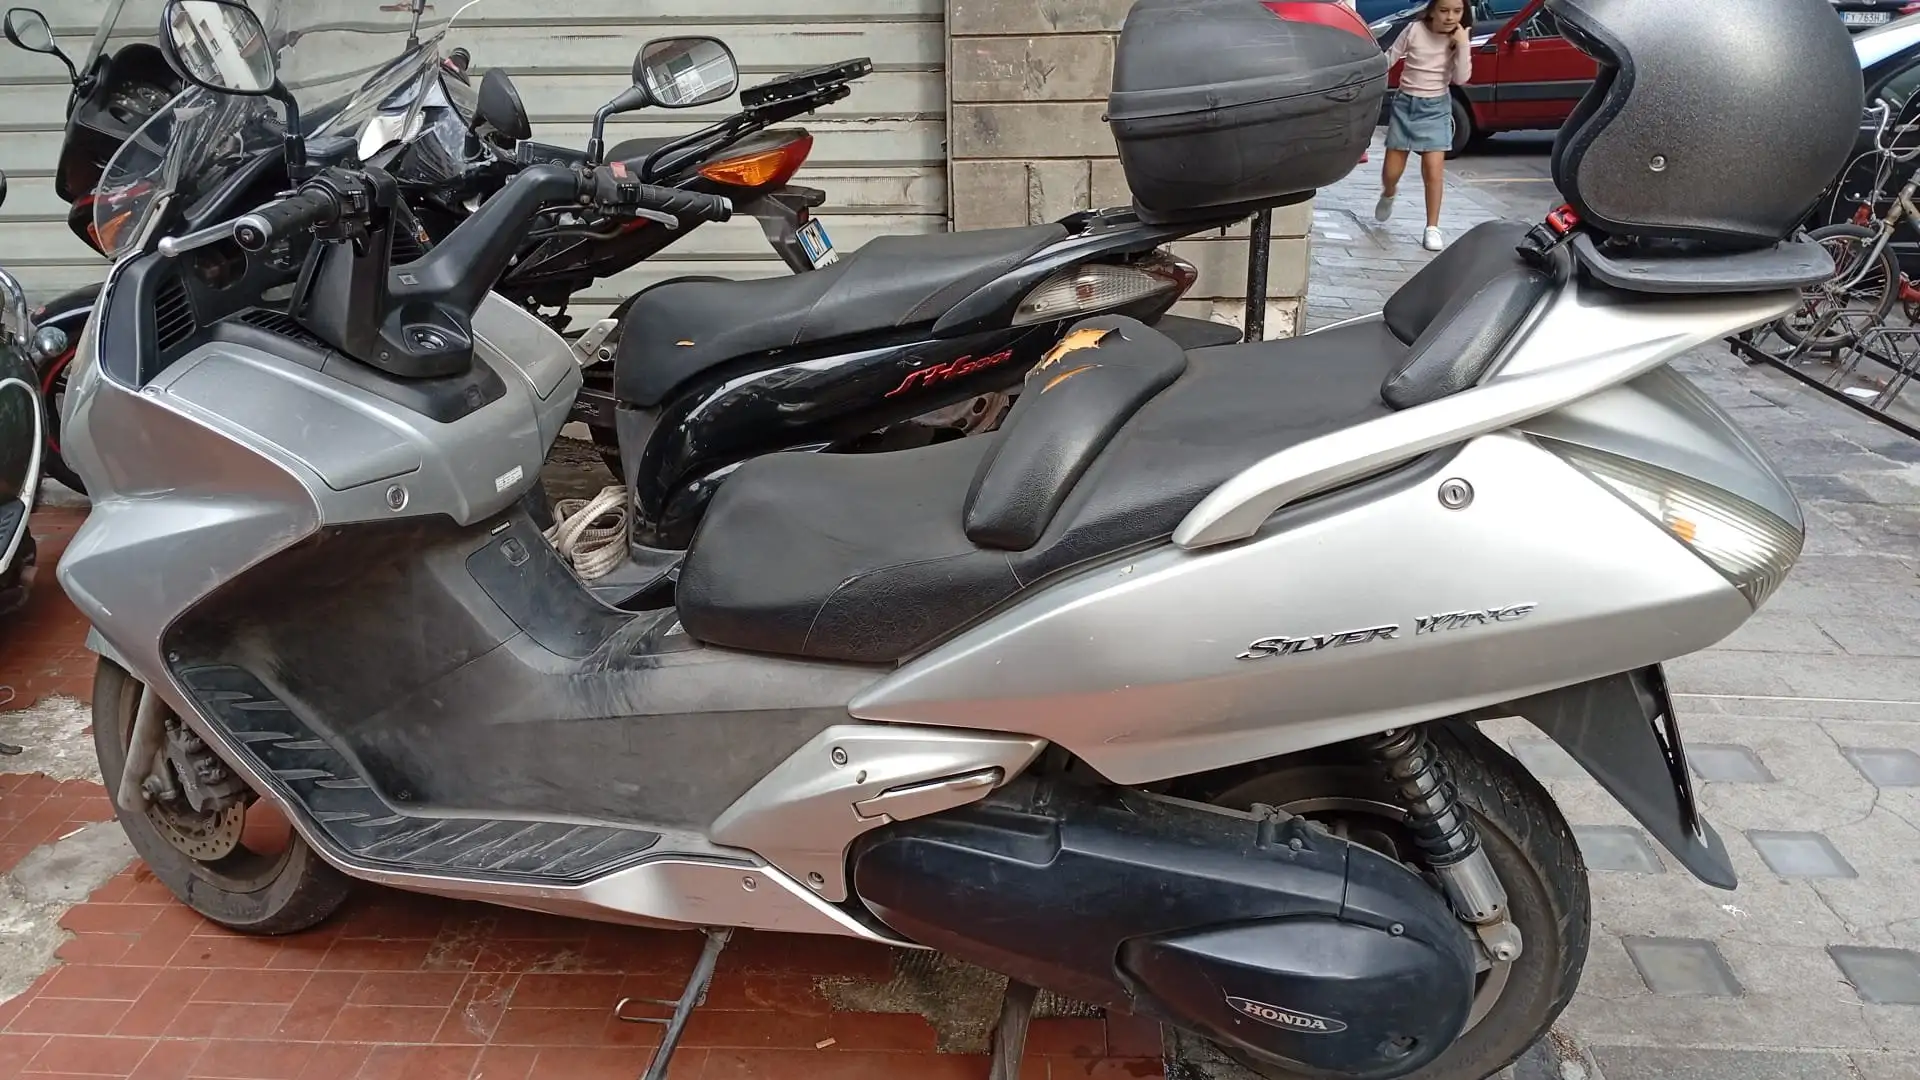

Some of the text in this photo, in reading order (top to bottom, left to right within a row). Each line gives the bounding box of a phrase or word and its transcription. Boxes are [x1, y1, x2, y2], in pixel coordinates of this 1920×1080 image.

[1235, 602, 1538, 660] SILVER WING
[1244, 1001, 1328, 1030] HONDA
